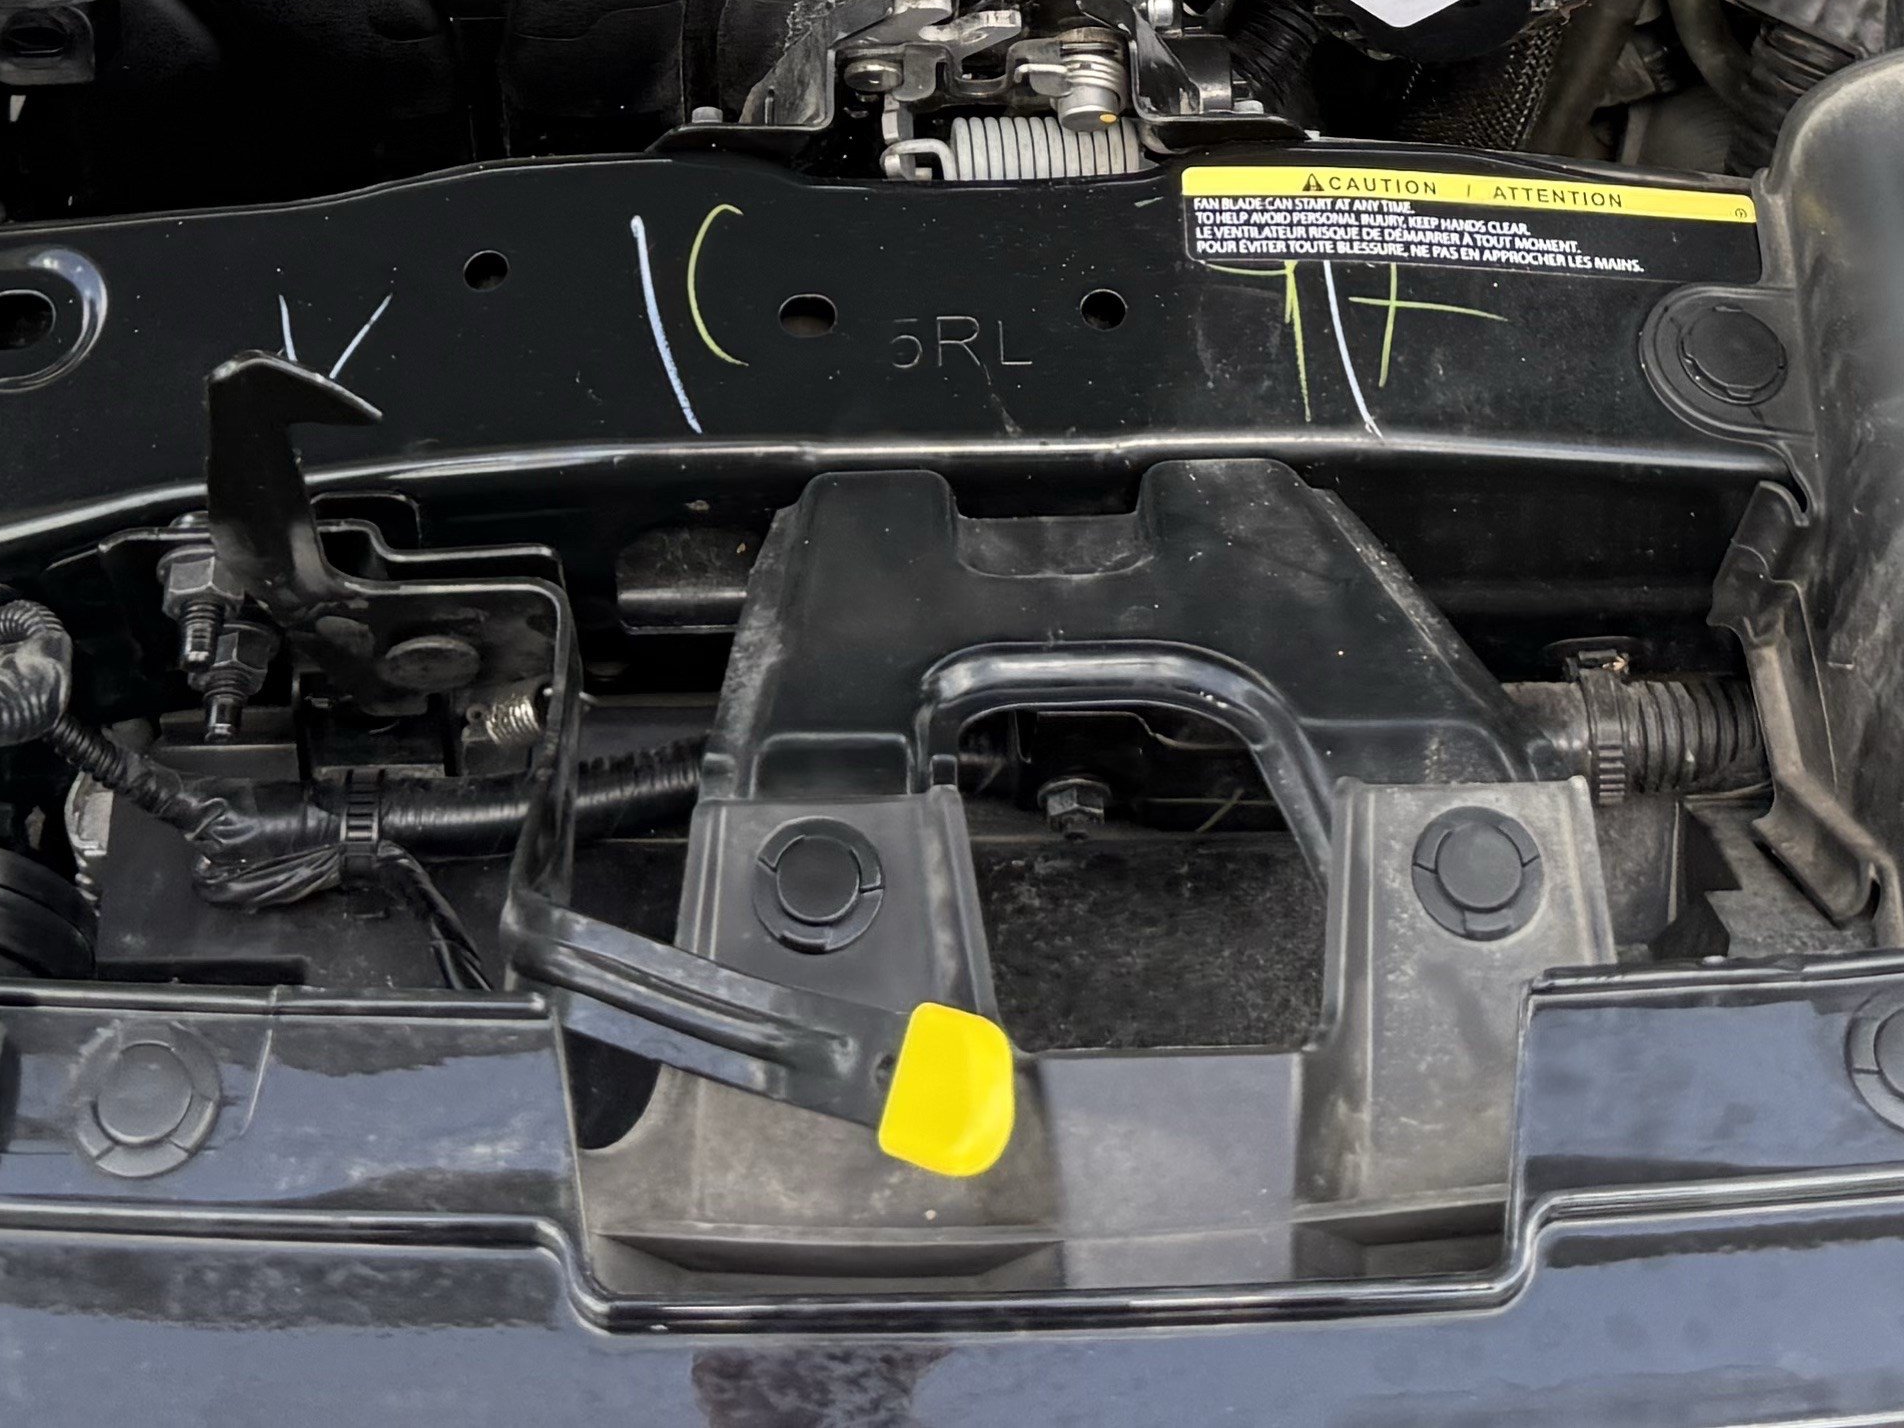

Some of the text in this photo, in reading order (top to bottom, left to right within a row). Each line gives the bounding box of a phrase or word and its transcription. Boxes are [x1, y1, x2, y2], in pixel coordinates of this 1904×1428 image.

[1194, 197, 1221, 210] FAN
[1222, 197, 1264, 210] BLADE
[1265, 198, 1293, 210] CAN
[1296, 198, 1333, 211] START
[1335, 199, 1351, 211] AT
[1353, 200, 1380, 212] ANY
[1329, 176, 1436, 195] CAUTION
[1493, 186, 1622, 208] ATTENTION
[1195, 212, 1213, 223] TO
[1216, 212, 1248, 224] HELP
[1250, 213, 1291, 225] AVOID
[1293, 213, 1358, 226] PERSONAL
[1408, 216, 1439, 229] KEEP
[1441, 219, 1486, 231] HANDS
[1196, 226, 1581, 253] LE VENTILATEUR RISQUE DE DÉMARRER À TOUT MOMENT.
[1197, 238, 1645, 273] POUR ÉVITER TOUTE BLESSURE, NE PAS EN APPROCHER LES MAINS.
